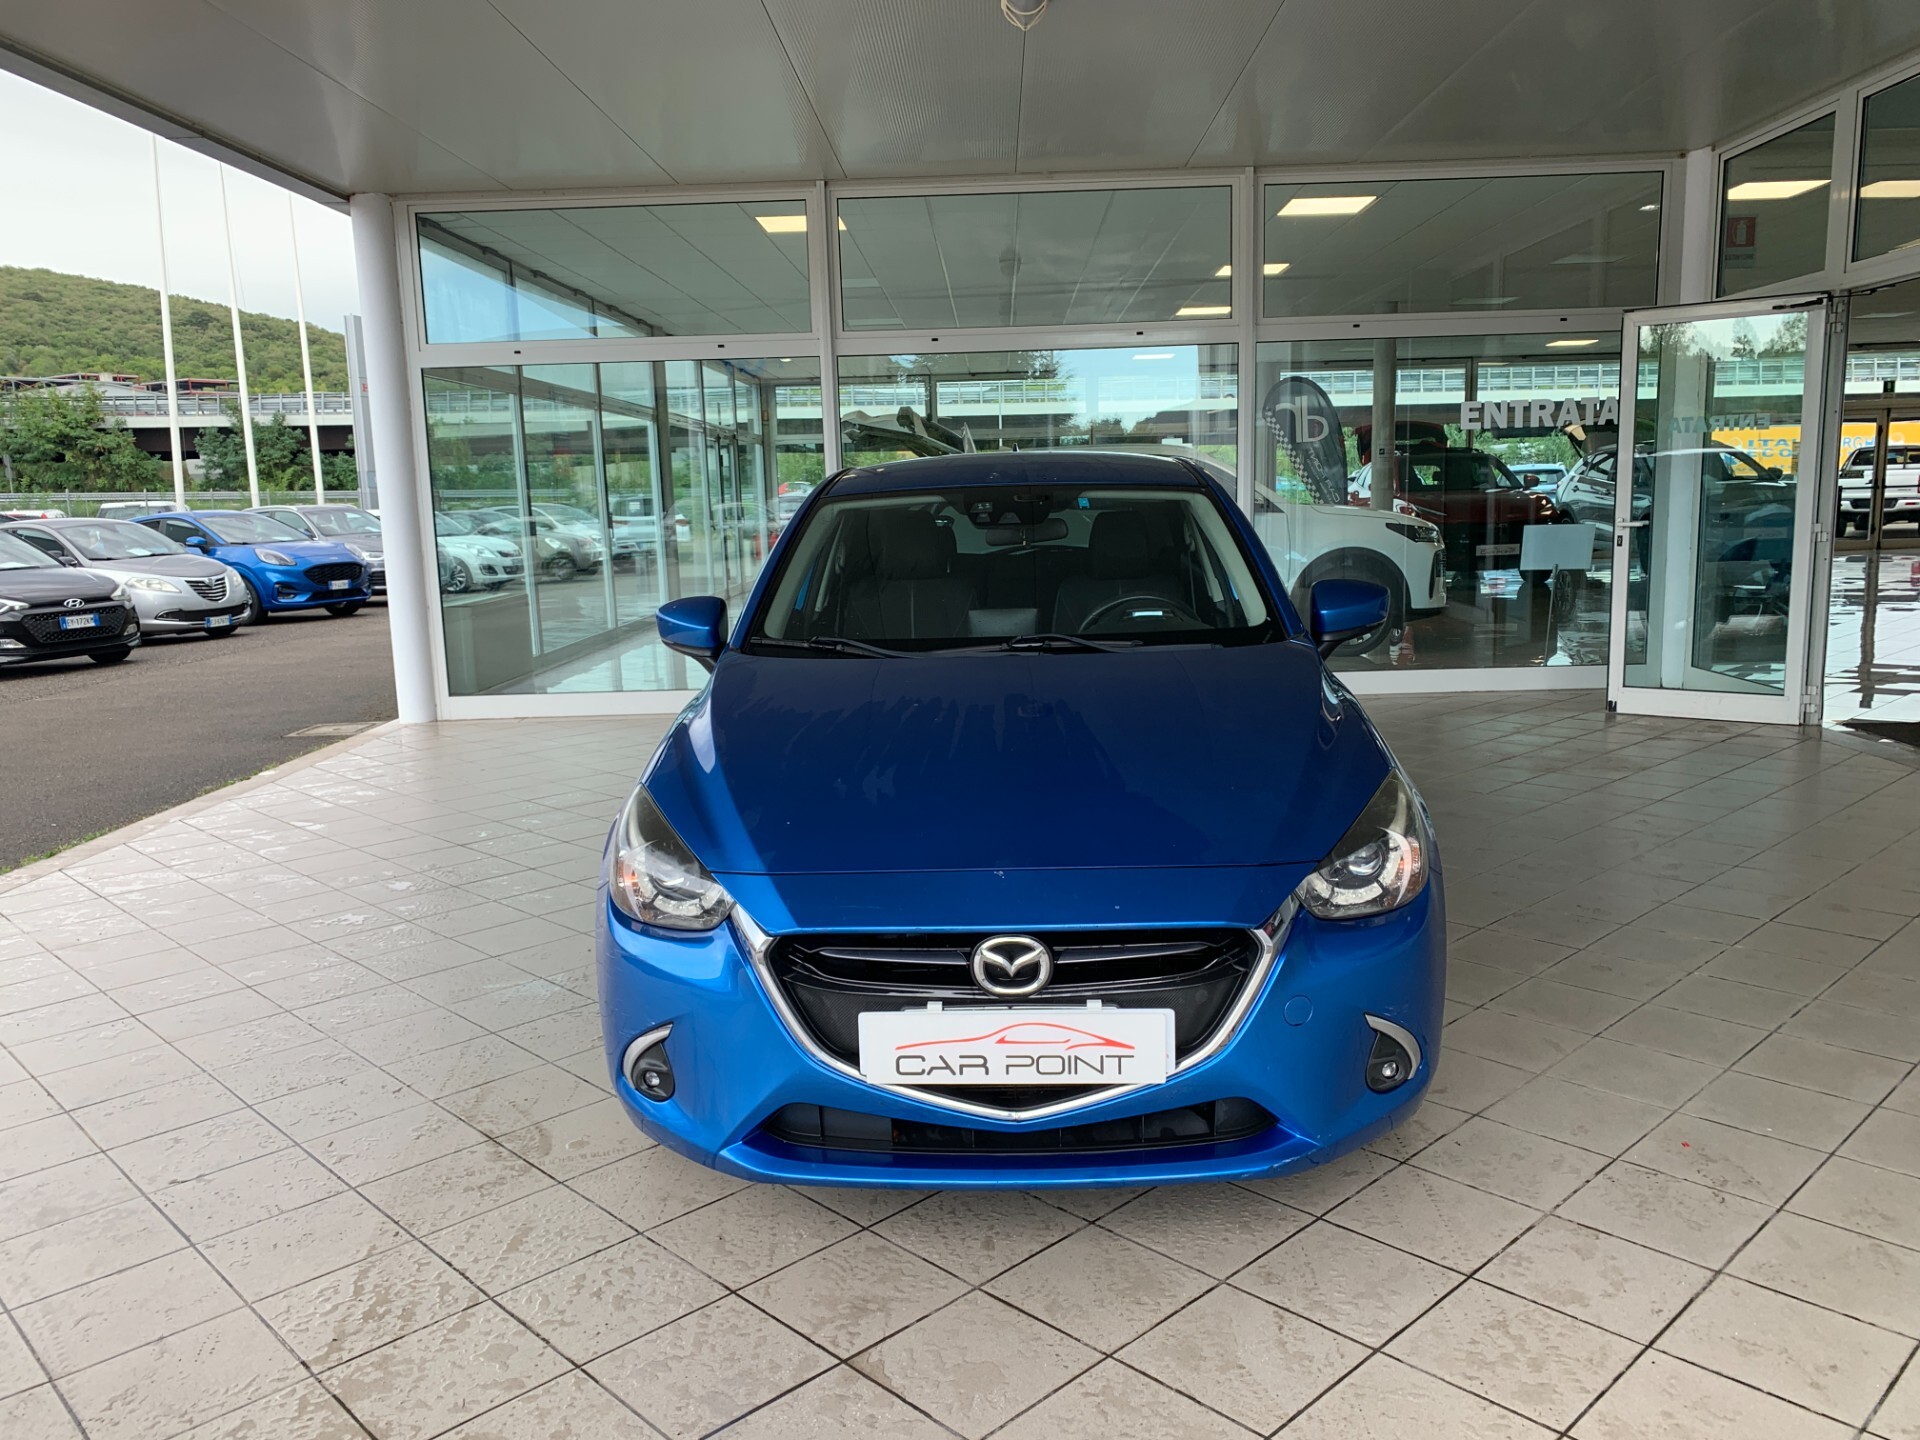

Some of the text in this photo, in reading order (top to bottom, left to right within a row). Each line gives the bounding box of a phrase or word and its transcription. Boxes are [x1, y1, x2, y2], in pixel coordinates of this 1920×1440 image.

[1460, 396, 1618, 430] ENTRATA
[895, 1055, 1135, 1076] CAR POINT
